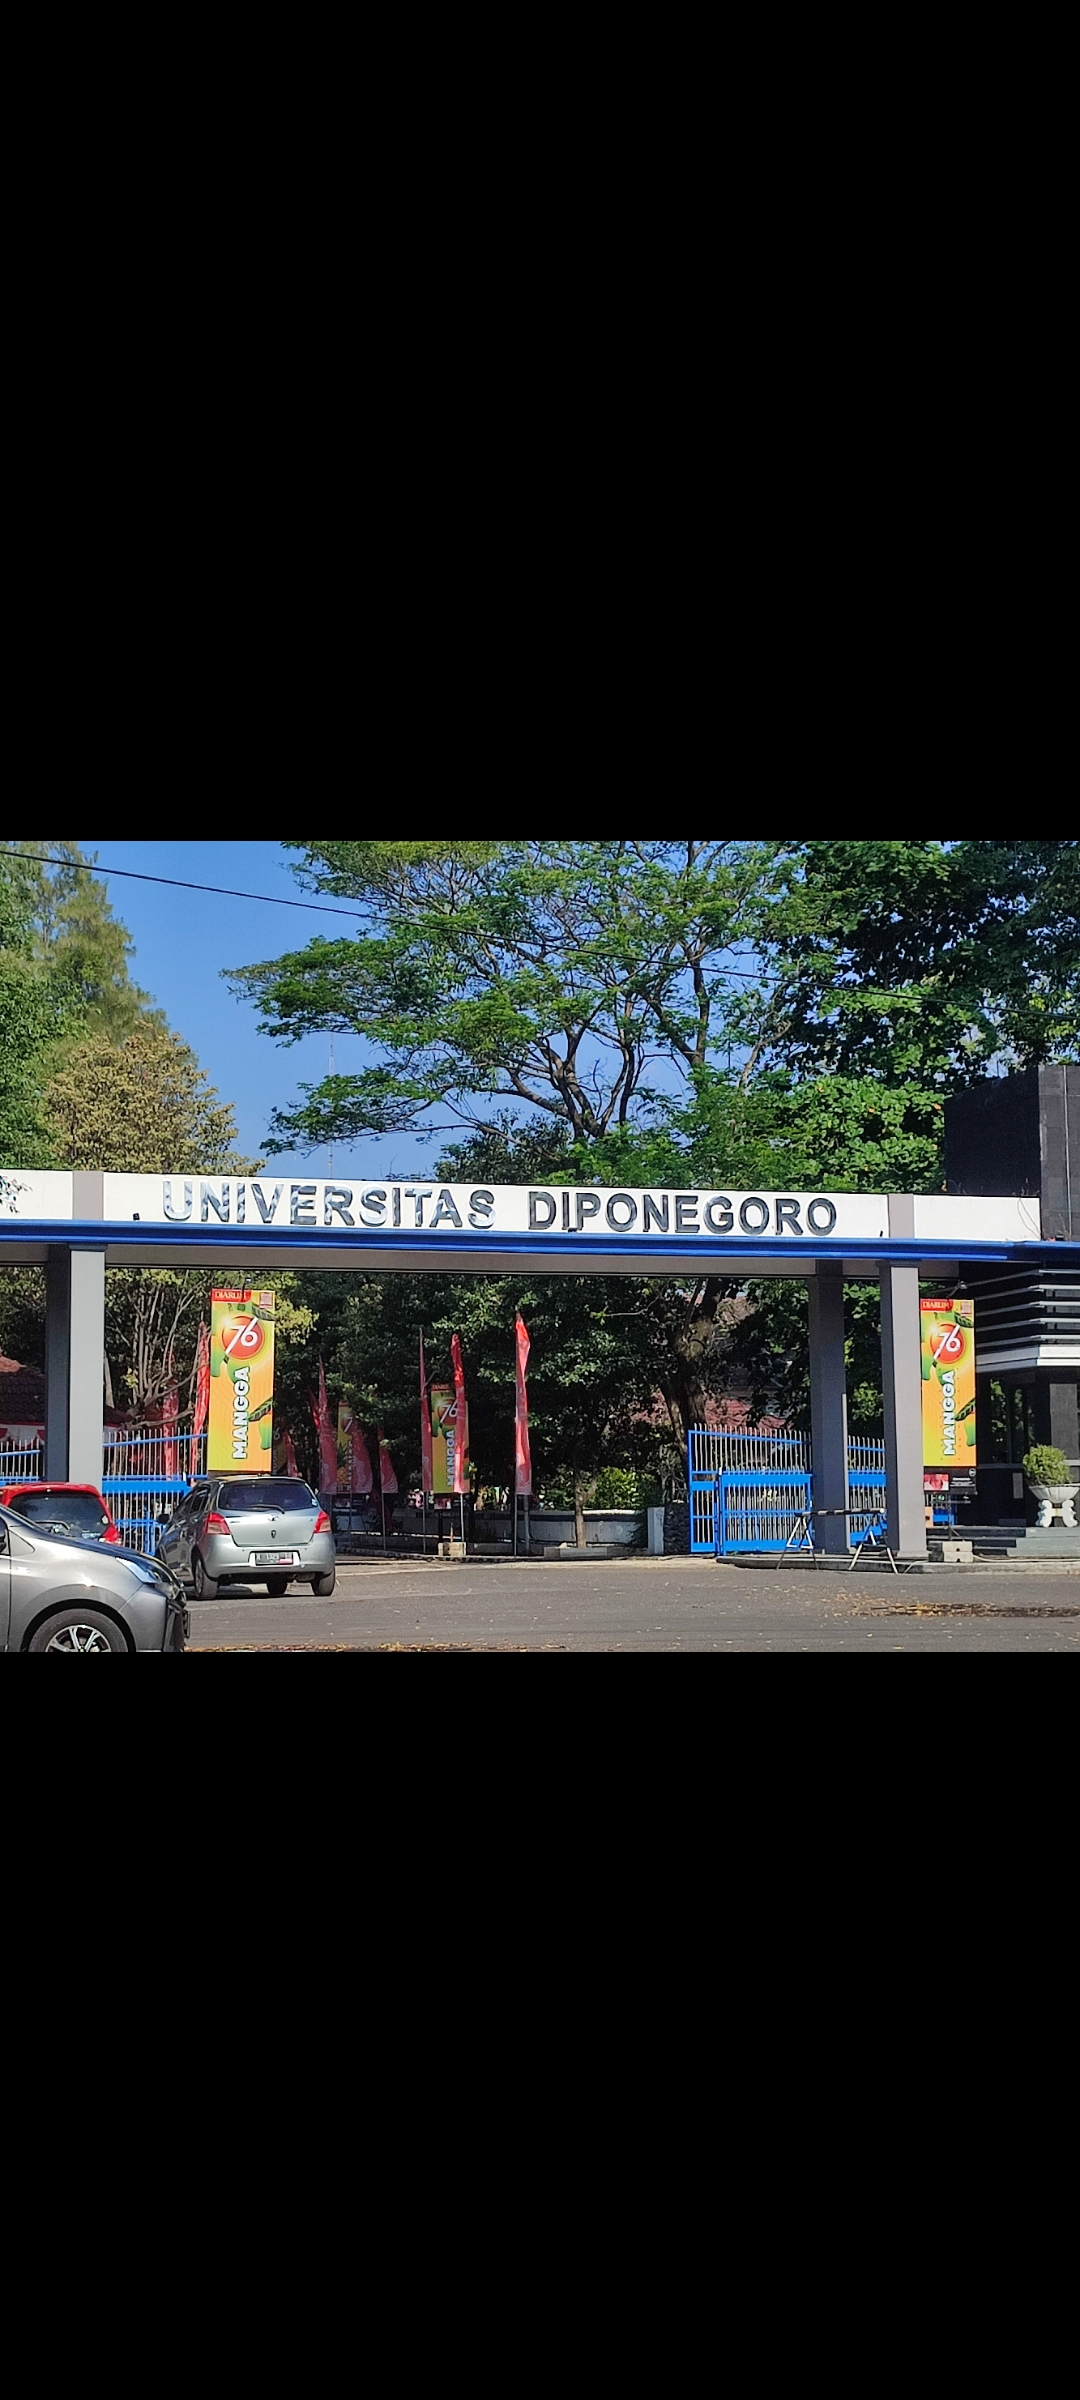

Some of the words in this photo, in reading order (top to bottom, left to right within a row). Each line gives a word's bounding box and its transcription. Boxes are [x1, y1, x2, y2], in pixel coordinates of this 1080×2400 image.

[162, 1180, 496, 1229] UNIVERSITAS
[527, 1191, 838, 1236] DIPONEGORO
[225, 1316, 258, 1355] 76
[933, 1324, 961, 1360] 76
[232, 1365, 250, 1459] MANGGA
[440, 1400, 458, 1424] 76
[942, 1369, 956, 1455] MANGGA
[446, 1430, 456, 1486] MANGGA
